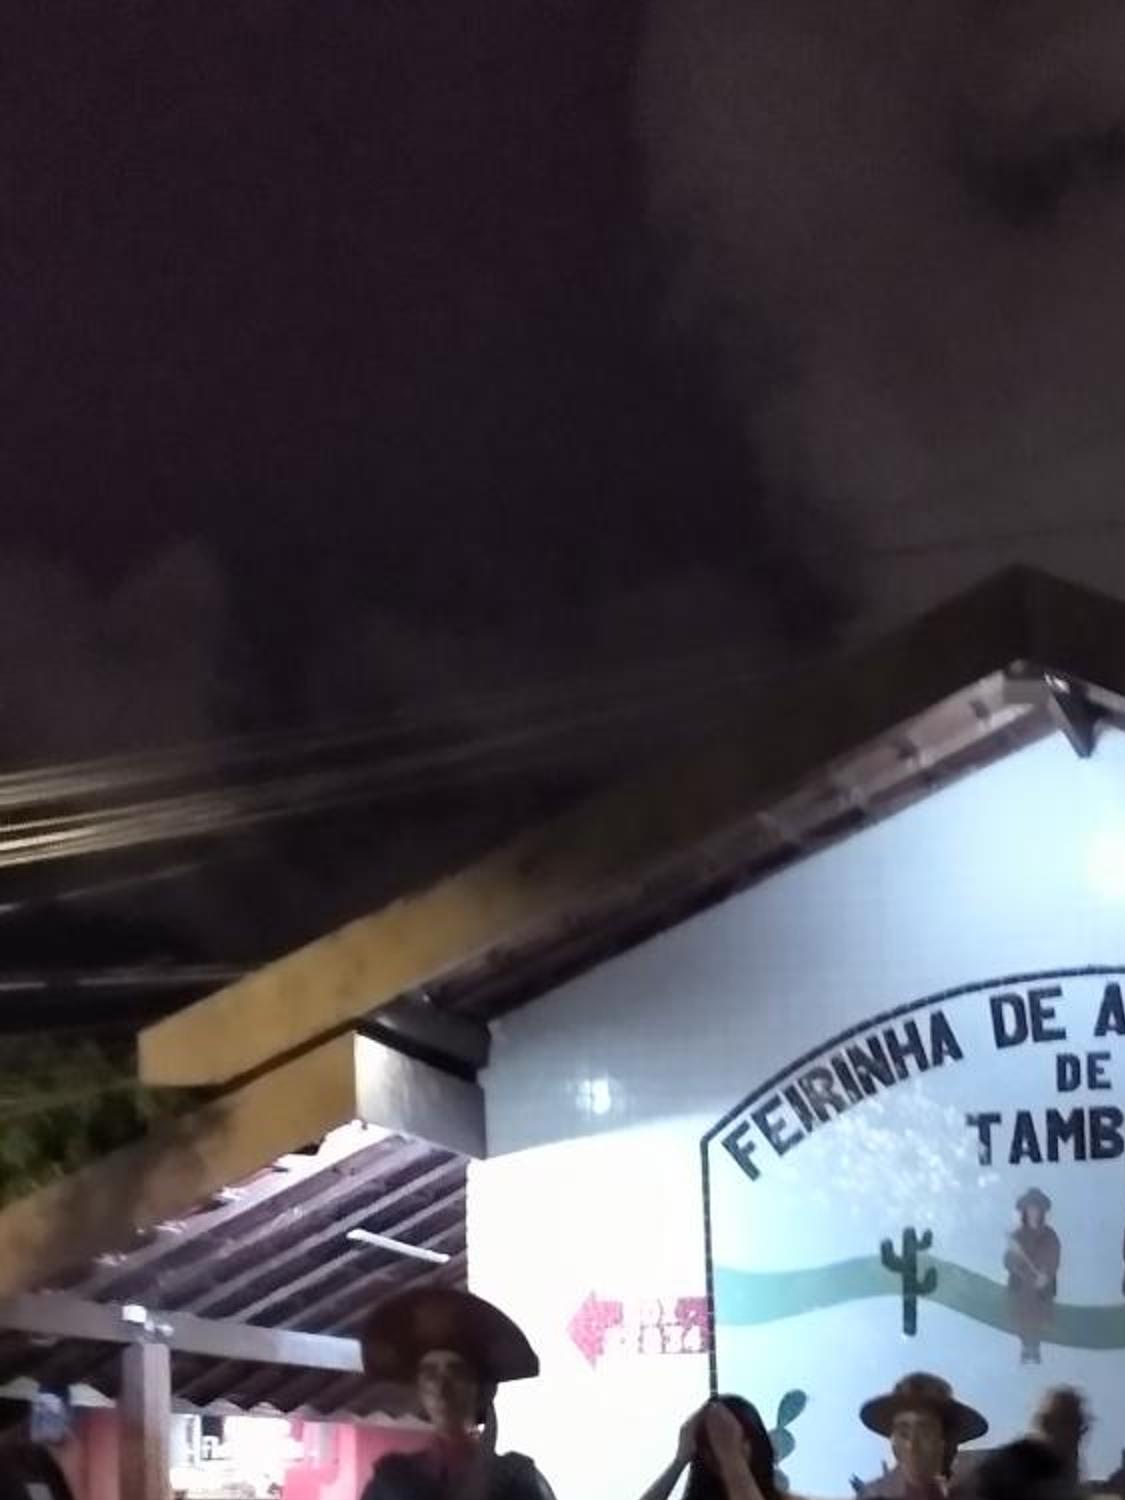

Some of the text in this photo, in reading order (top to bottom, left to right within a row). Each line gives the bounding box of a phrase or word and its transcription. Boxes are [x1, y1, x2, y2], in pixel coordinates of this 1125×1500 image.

[721, 1009, 964, 1182] FEIRINHA
[989, 984, 1068, 1051] DE
[1056, 1051, 1112, 1093] DE
